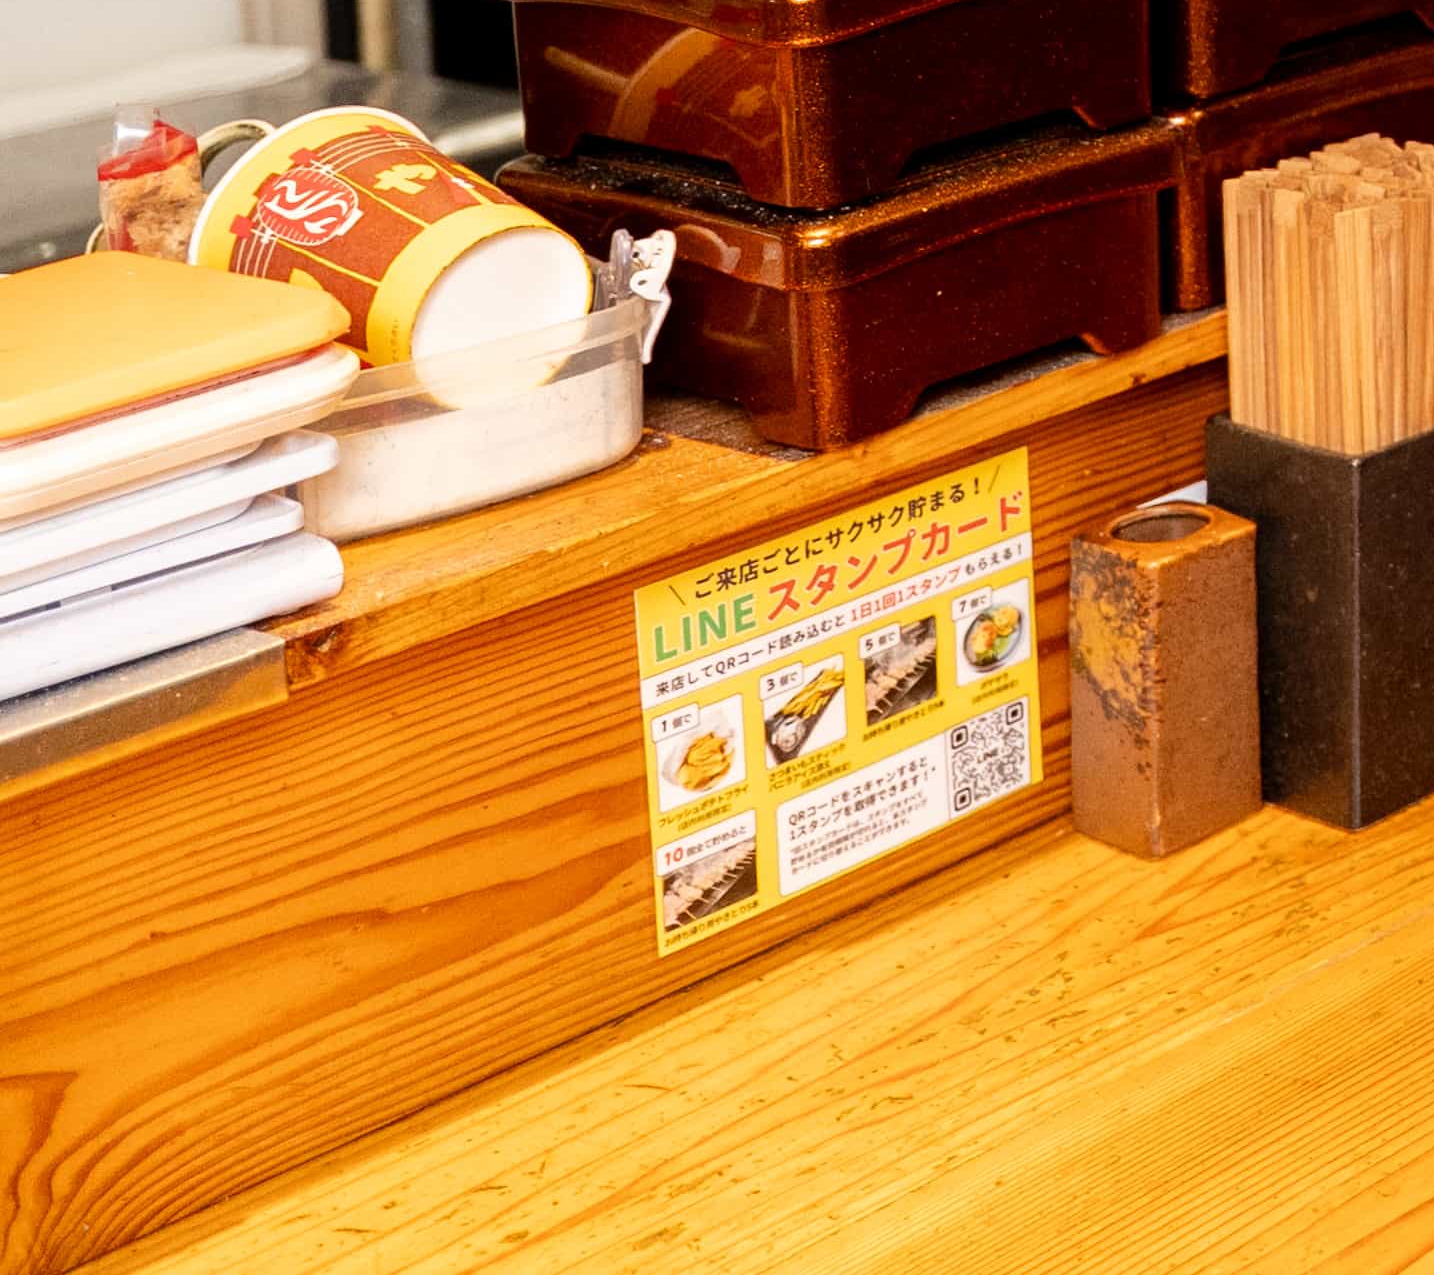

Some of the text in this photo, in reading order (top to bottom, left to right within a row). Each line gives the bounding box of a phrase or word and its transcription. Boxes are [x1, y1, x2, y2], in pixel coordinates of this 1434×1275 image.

[654, 490, 1023, 663] LINE スタンプカード
[958, 600, 967, 612] 7
[865, 638, 874, 651] 5
[766, 677, 776, 691] 3
[661, 720, 668, 733] 1
[977, 749, 998, 764] LINE
[663, 847, 684, 867] 10
